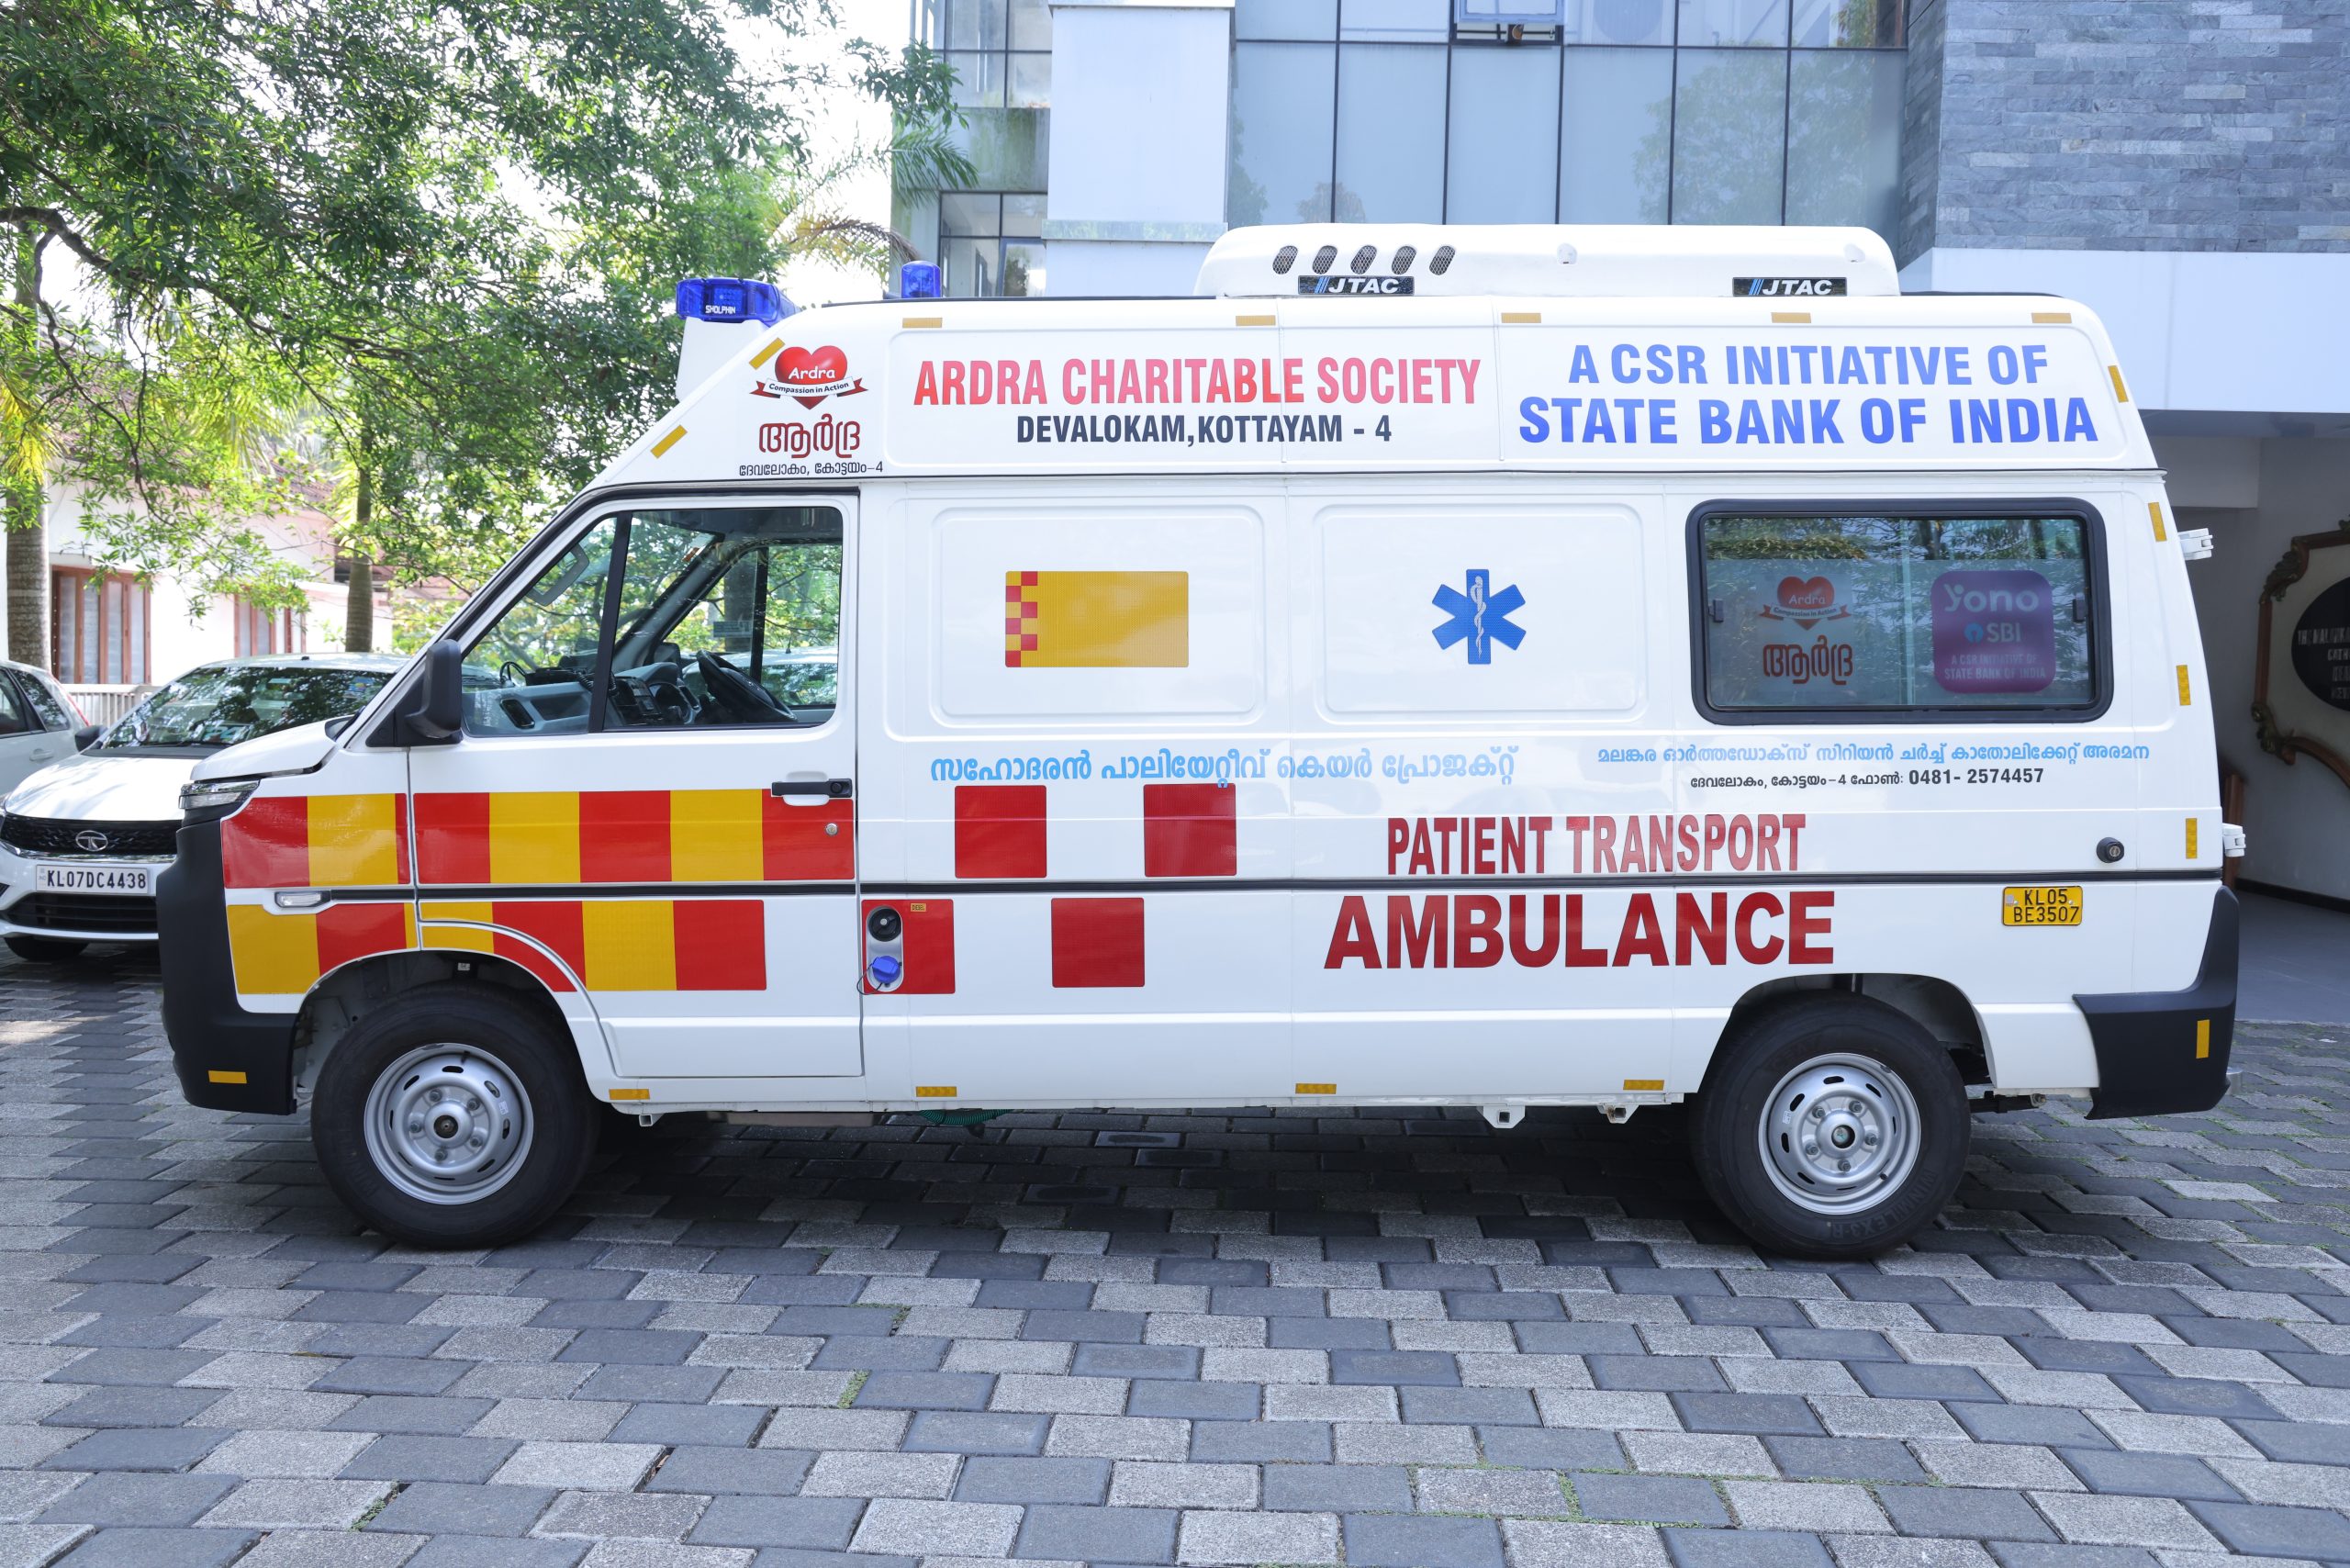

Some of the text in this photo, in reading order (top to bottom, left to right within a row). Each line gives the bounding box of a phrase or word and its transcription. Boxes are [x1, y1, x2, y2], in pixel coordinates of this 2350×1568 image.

[1328, 278, 1399, 293] JTAC
[1762, 279, 1833, 296] JTAC
[789, 366, 835, 379] Ardra
[1569, 344, 2047, 385] A CSR INITIATIVE OF
[768, 383, 814, 394] Compassion
[824, 382, 849, 392] Action
[914, 357, 1481, 405] ARDRA CHARITABLE SOCIETY
[1375, 415, 1392, 442] 4
[1520, 397, 2098, 443] STATE BANK OF INDIA
[759, 413, 860, 458] ആർദ്ര
[1788, 594, 1825, 605] Ardra
[1774, 608, 1810, 617] Compassion
[1986, 622, 2020, 643] SBI
[1763, 634, 1852, 685] ആർദ്ര
[1944, 668, 1972, 679] STATE
[1975, 668, 2000, 678] BANK
[2020, 668, 2045, 678] INDIA
[1597, 748, 1656, 763] മലങ്കര
[2083, 744, 2150, 759] അരമന
[1967, 768, 2043, 784] 2574457
[1387, 813, 1806, 876] PATIENT TRANSPORT
[48, 870, 146, 889] KL07DC4438
[2024, 889, 2067, 905] KL05
[2013, 906, 2081, 923] BE3507
[1325, 890, 1834, 969] AMBULANCE
